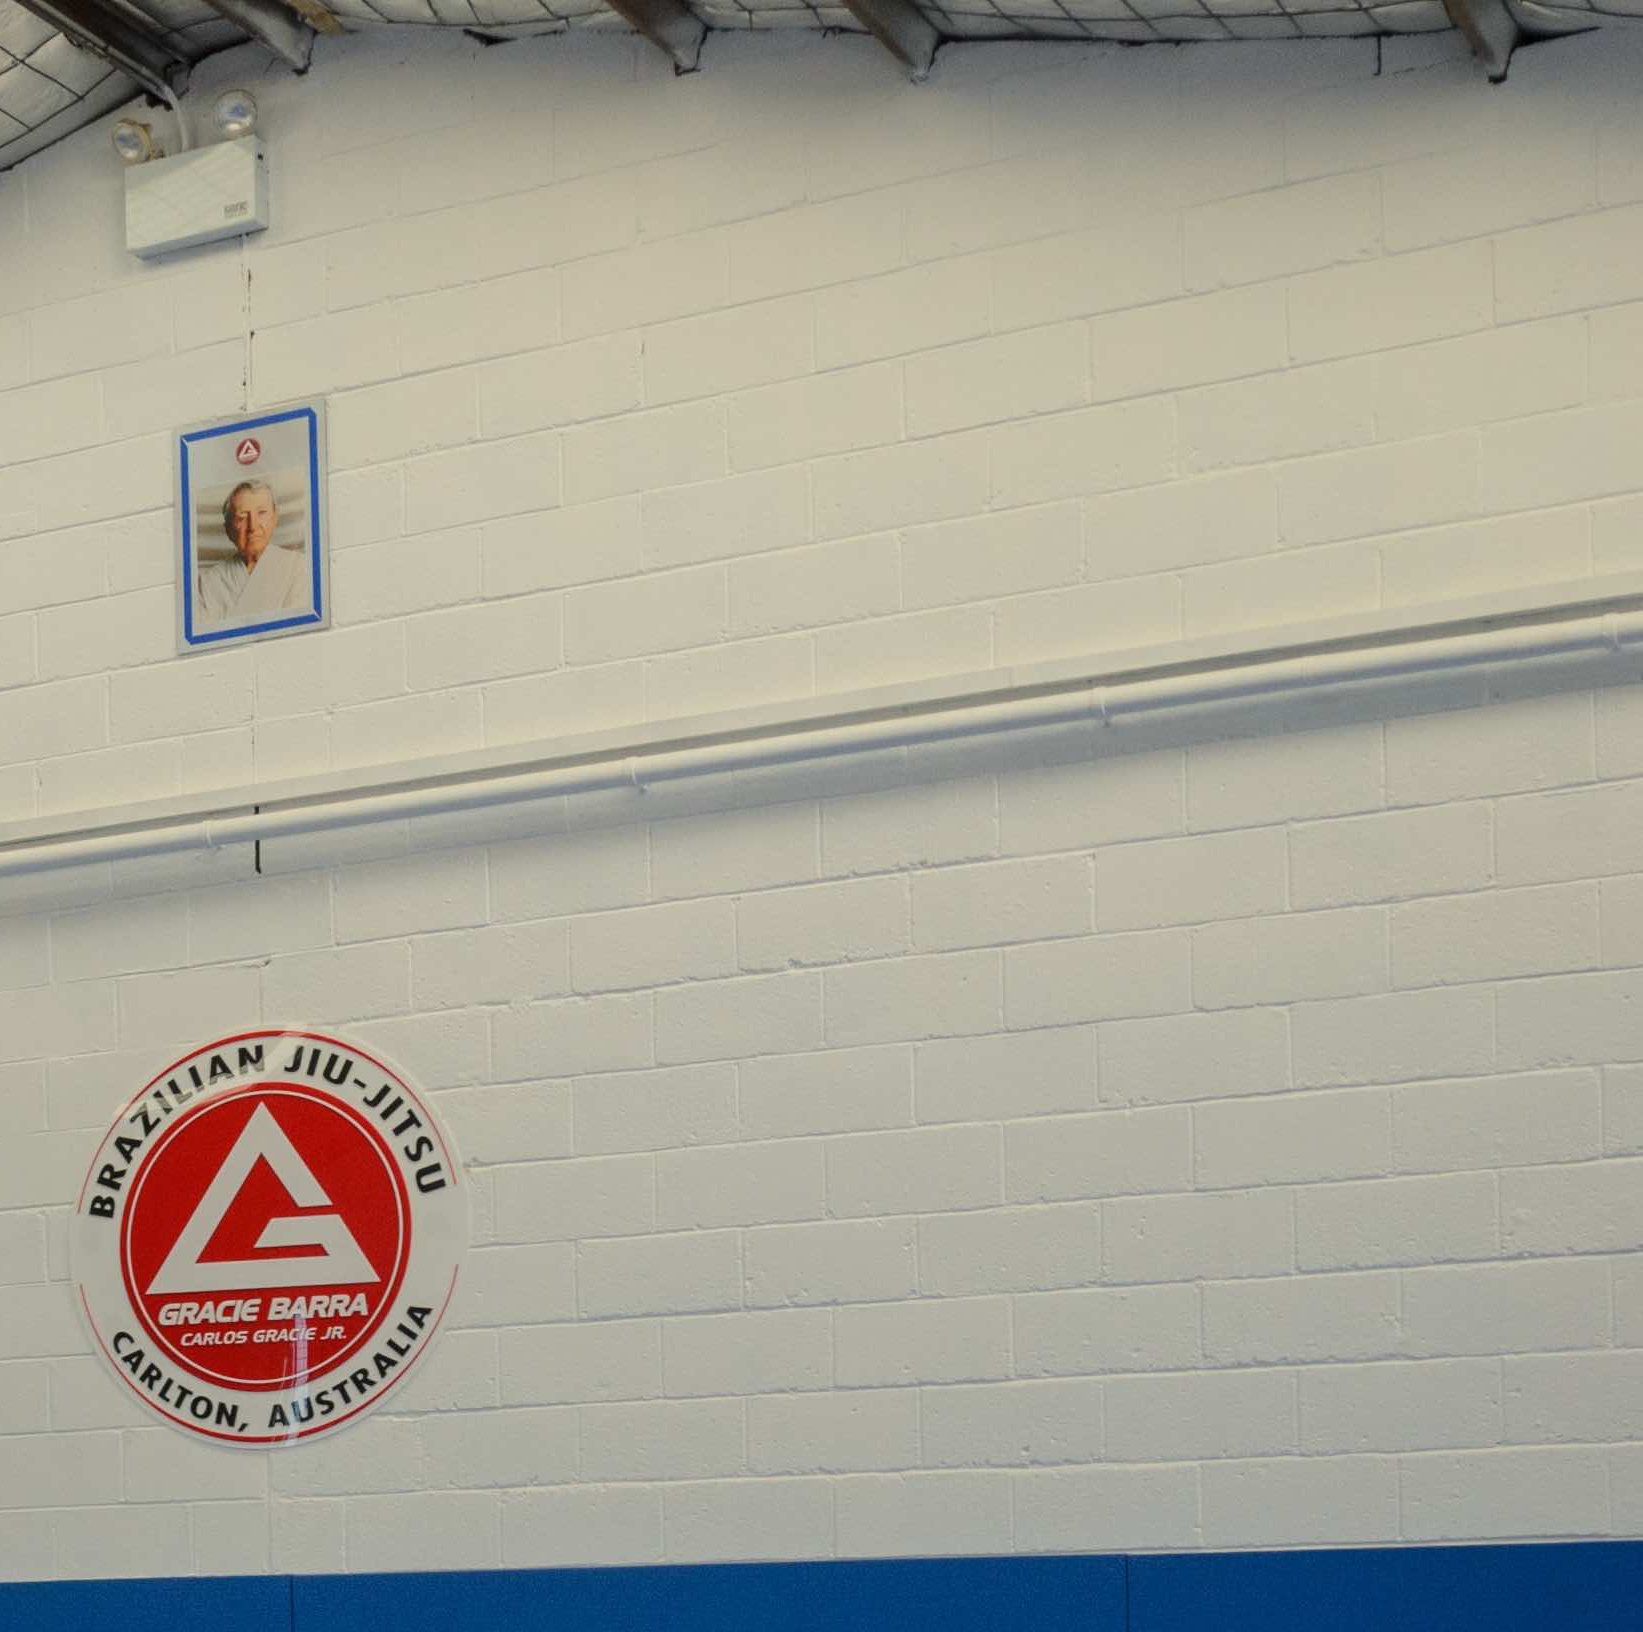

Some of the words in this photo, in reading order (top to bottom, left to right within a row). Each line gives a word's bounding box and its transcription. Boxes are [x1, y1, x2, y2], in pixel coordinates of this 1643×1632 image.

[89, 1044, 264, 1219] BRAZILIAN
[285, 1046, 447, 1194] JIU-JITSU
[158, 1298, 262, 1326] GRACIE
[267, 1293, 369, 1321] BARRA
[180, 1330, 248, 1347] CARLOS
[252, 1327, 317, 1344] GRACIE
[320, 1326, 348, 1340] JR.
[112, 1329, 250, 1434] CARLTON,
[268, 1303, 434, 1429] AUSTRALIA
